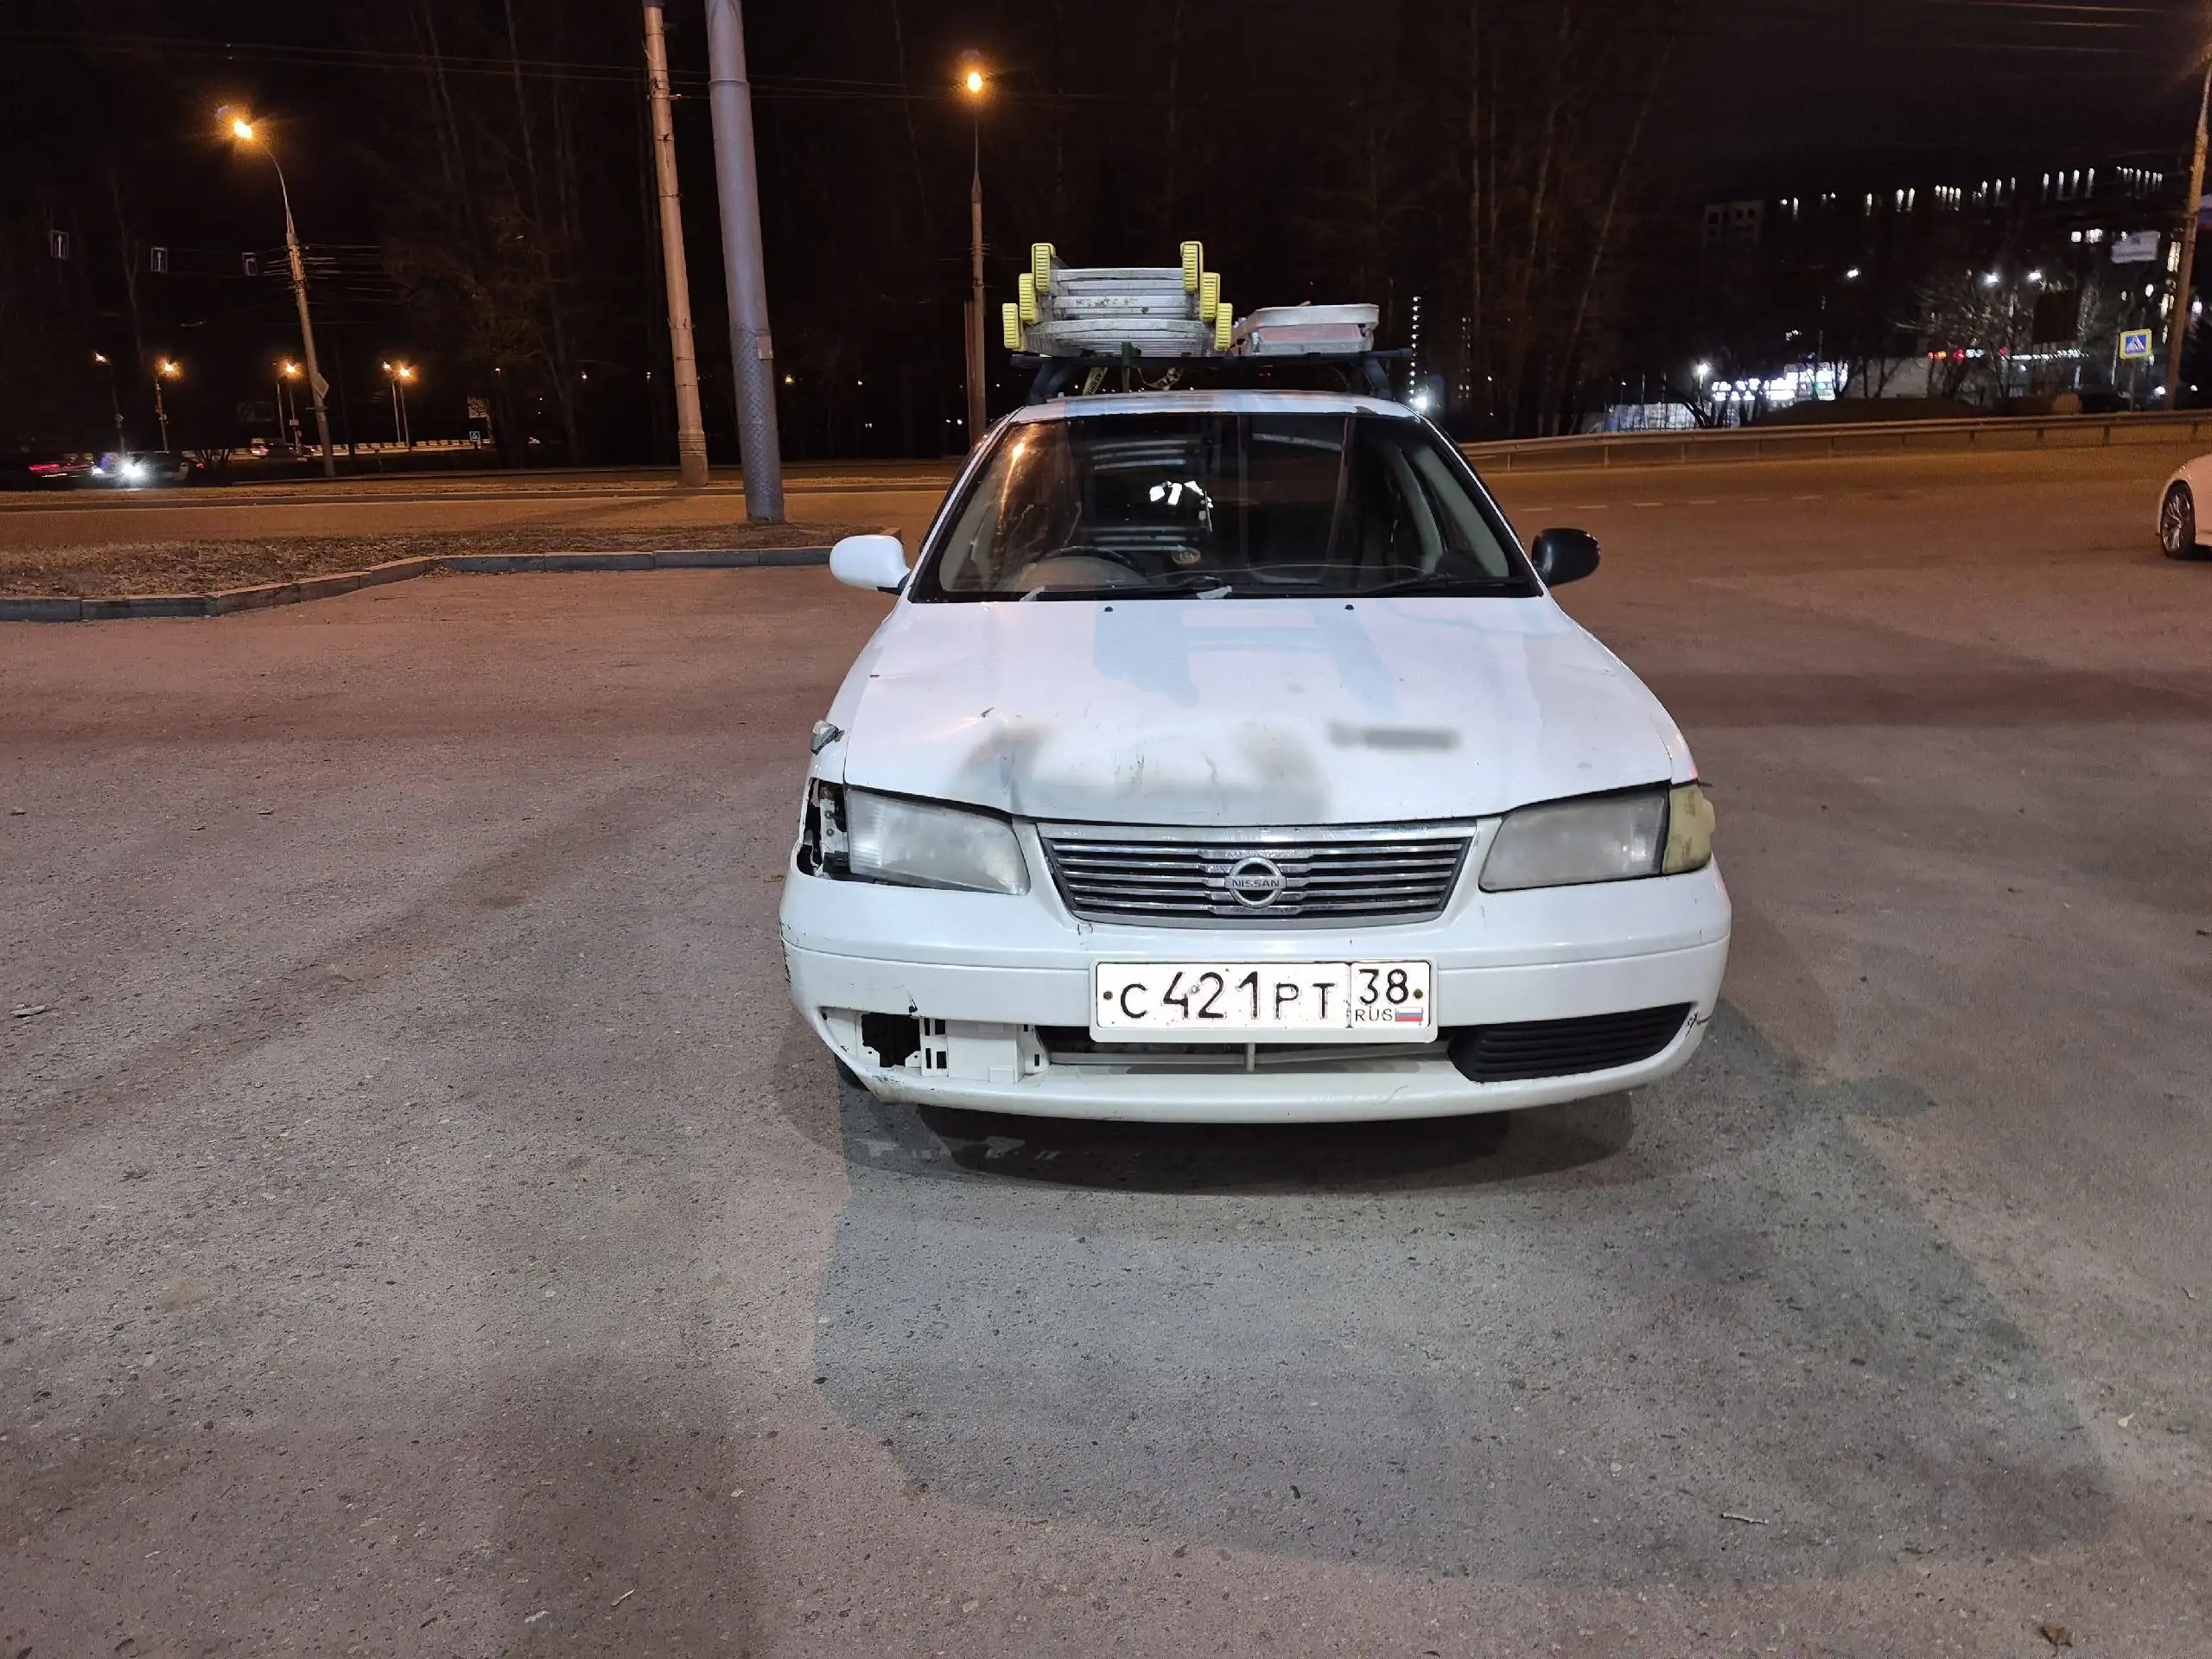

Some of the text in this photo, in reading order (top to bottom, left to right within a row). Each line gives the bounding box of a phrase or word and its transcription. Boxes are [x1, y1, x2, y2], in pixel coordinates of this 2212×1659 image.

[1232, 879, 1280, 888] NISSAN
[1358, 968, 1409, 1005] 38
[1355, 1007, 1393, 1021] RUS
